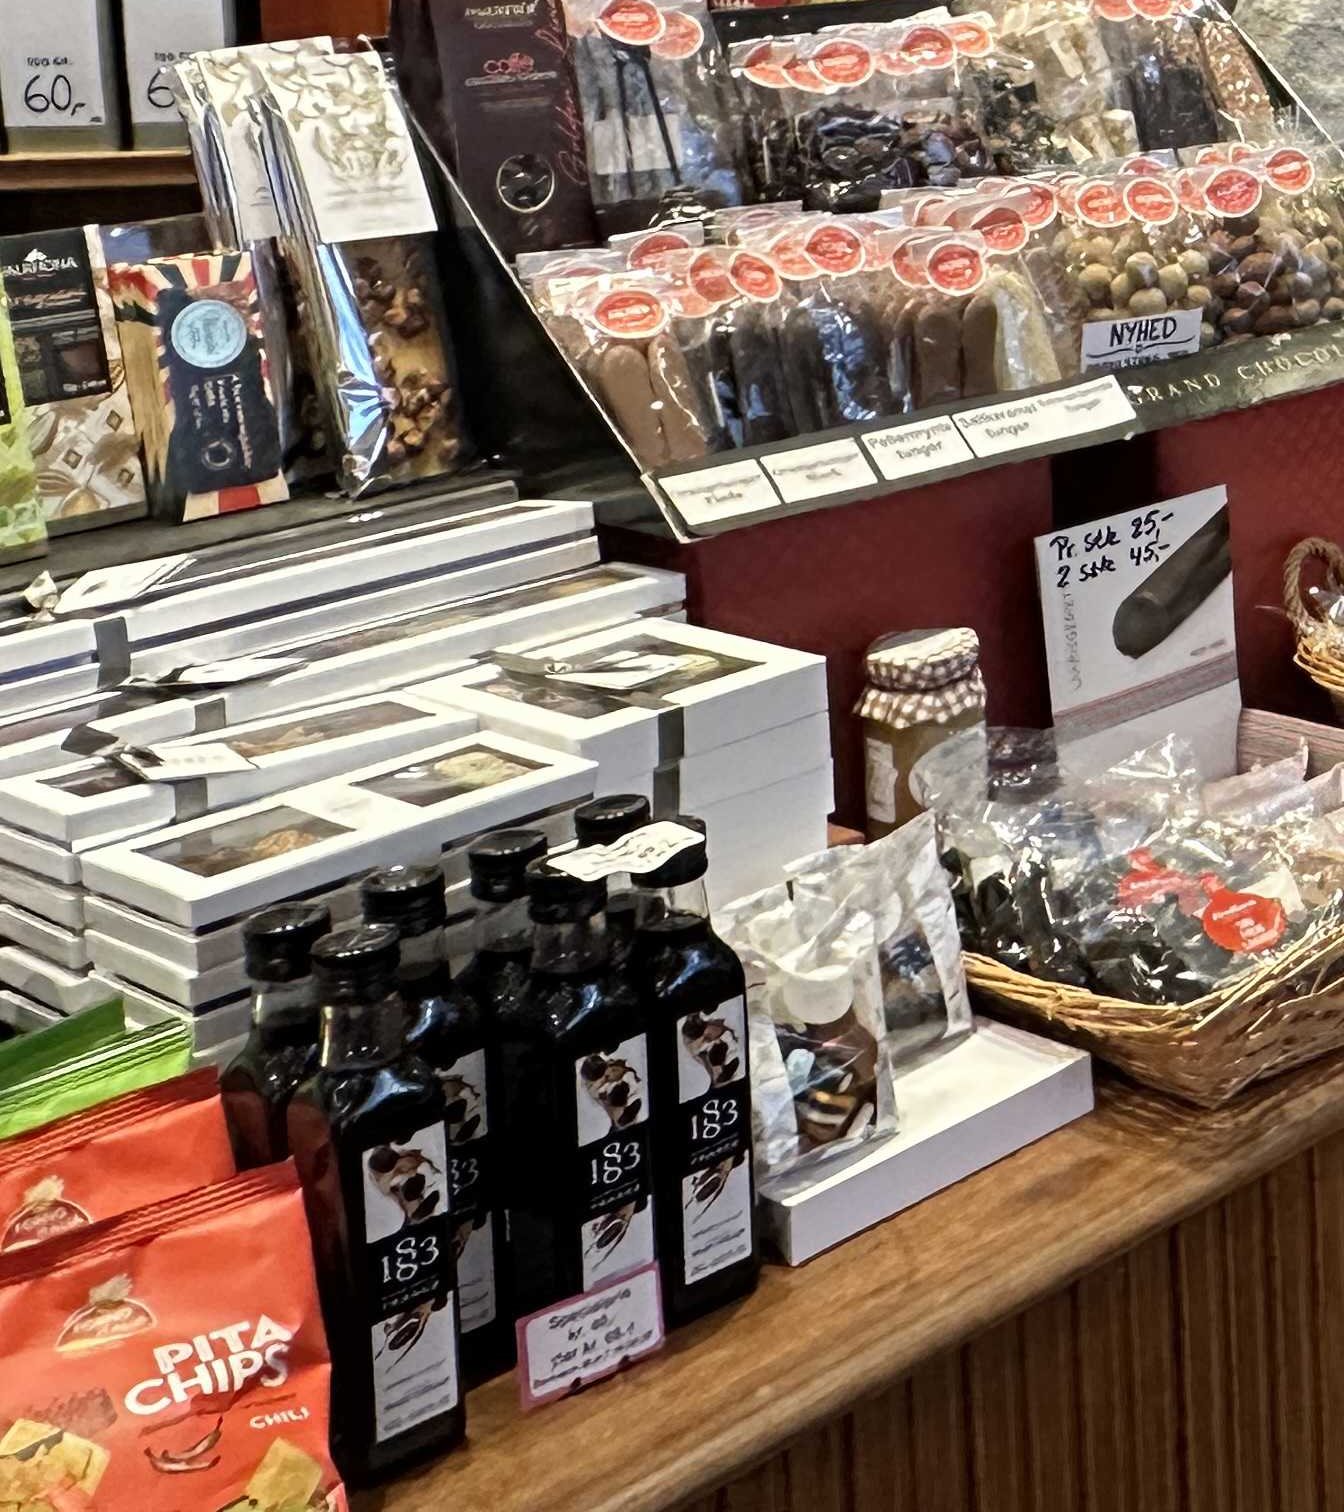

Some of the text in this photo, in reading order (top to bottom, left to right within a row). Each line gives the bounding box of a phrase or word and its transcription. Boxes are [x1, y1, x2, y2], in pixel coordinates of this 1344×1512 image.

[1109, 317, 1177, 348] NYHED
[1057, 564, 1072, 588] 2
[153, 1313, 294, 1374] PITA
[124, 1342, 290, 1416] CHIPS
[249, 1405, 311, 1429] CHILI
